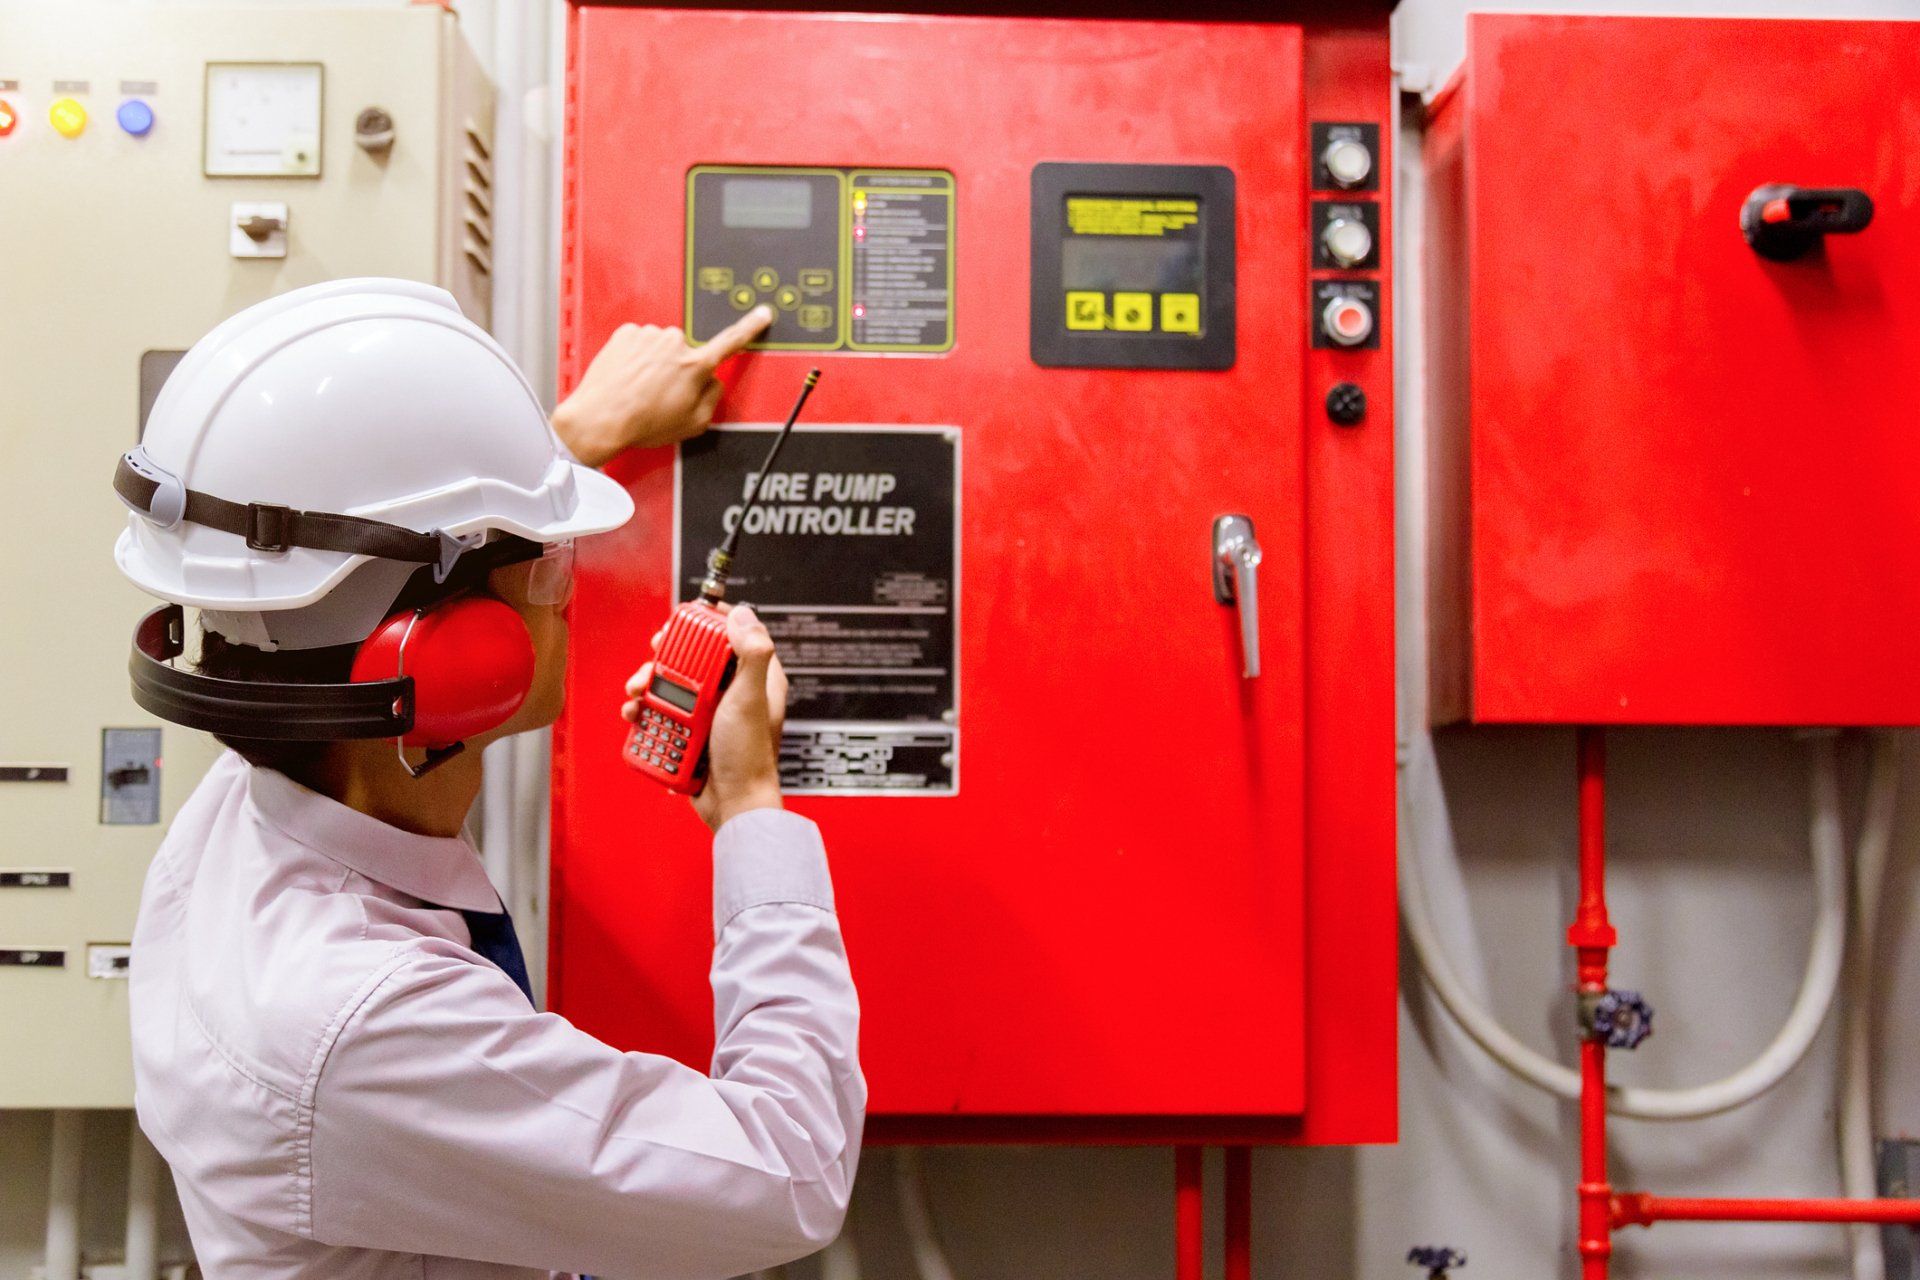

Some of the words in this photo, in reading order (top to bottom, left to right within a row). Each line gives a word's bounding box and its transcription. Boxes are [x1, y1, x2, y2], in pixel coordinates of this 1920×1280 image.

[743, 473, 809, 501] FIRE
[813, 474, 896, 502] PUMP
[723, 505, 916, 535] CONTROLLER
